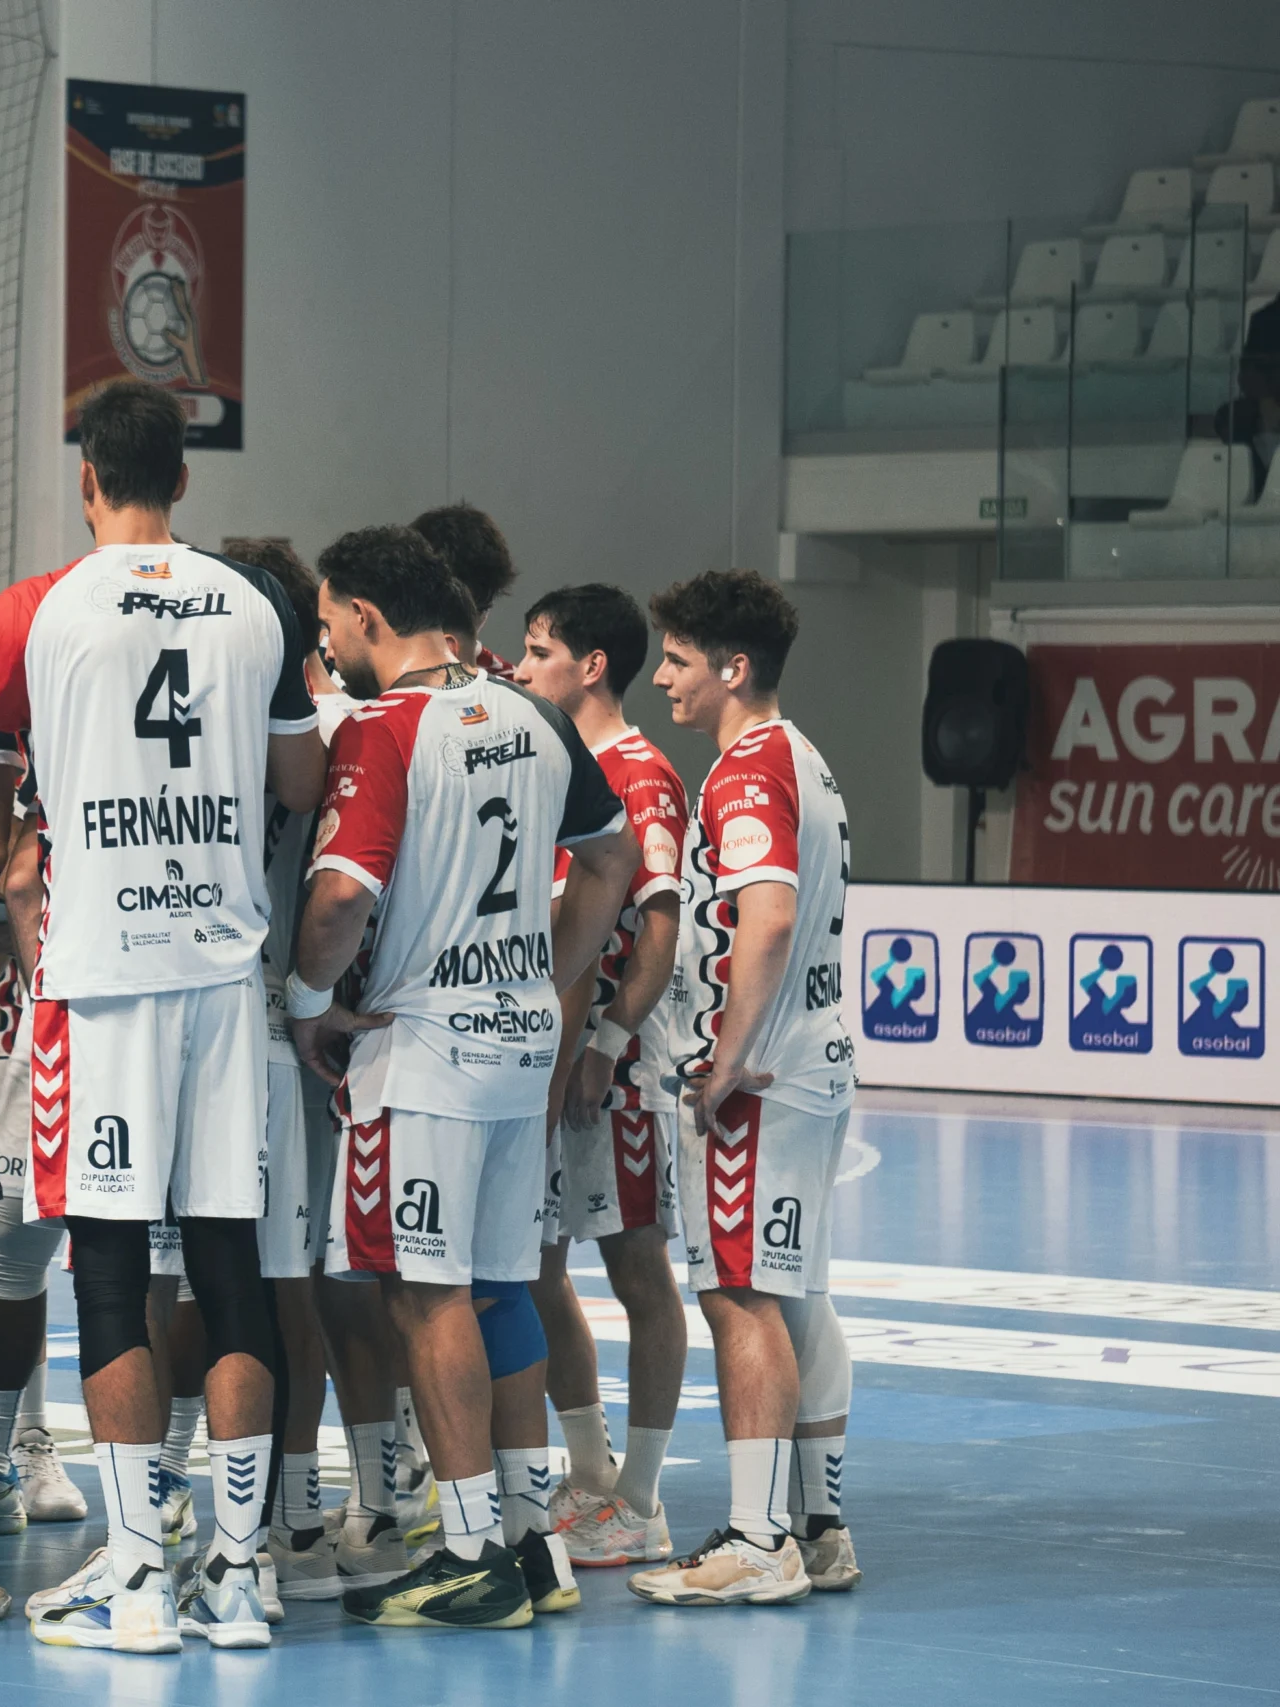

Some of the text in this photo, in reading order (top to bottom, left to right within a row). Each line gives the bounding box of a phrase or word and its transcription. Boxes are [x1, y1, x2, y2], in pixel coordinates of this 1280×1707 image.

[134, 648, 202, 769] 4
[718, 798, 755, 821] suma
[1043, 779, 1280, 838] sun care
[477, 797, 519, 917] 2
[873, 1020, 927, 1038] asobal
[976, 1024, 1032, 1042] asobal
[1082, 1028, 1139, 1048] asobal
[1192, 1033, 1251, 1051] asobal
[461, 1051, 503, 1060] GENERALITAT
[462, 1058, 502, 1066] VALENCIANA
[80, 1183, 136, 1193] DE ALICANTE
[403, 1245, 446, 1258] ALICANTE
